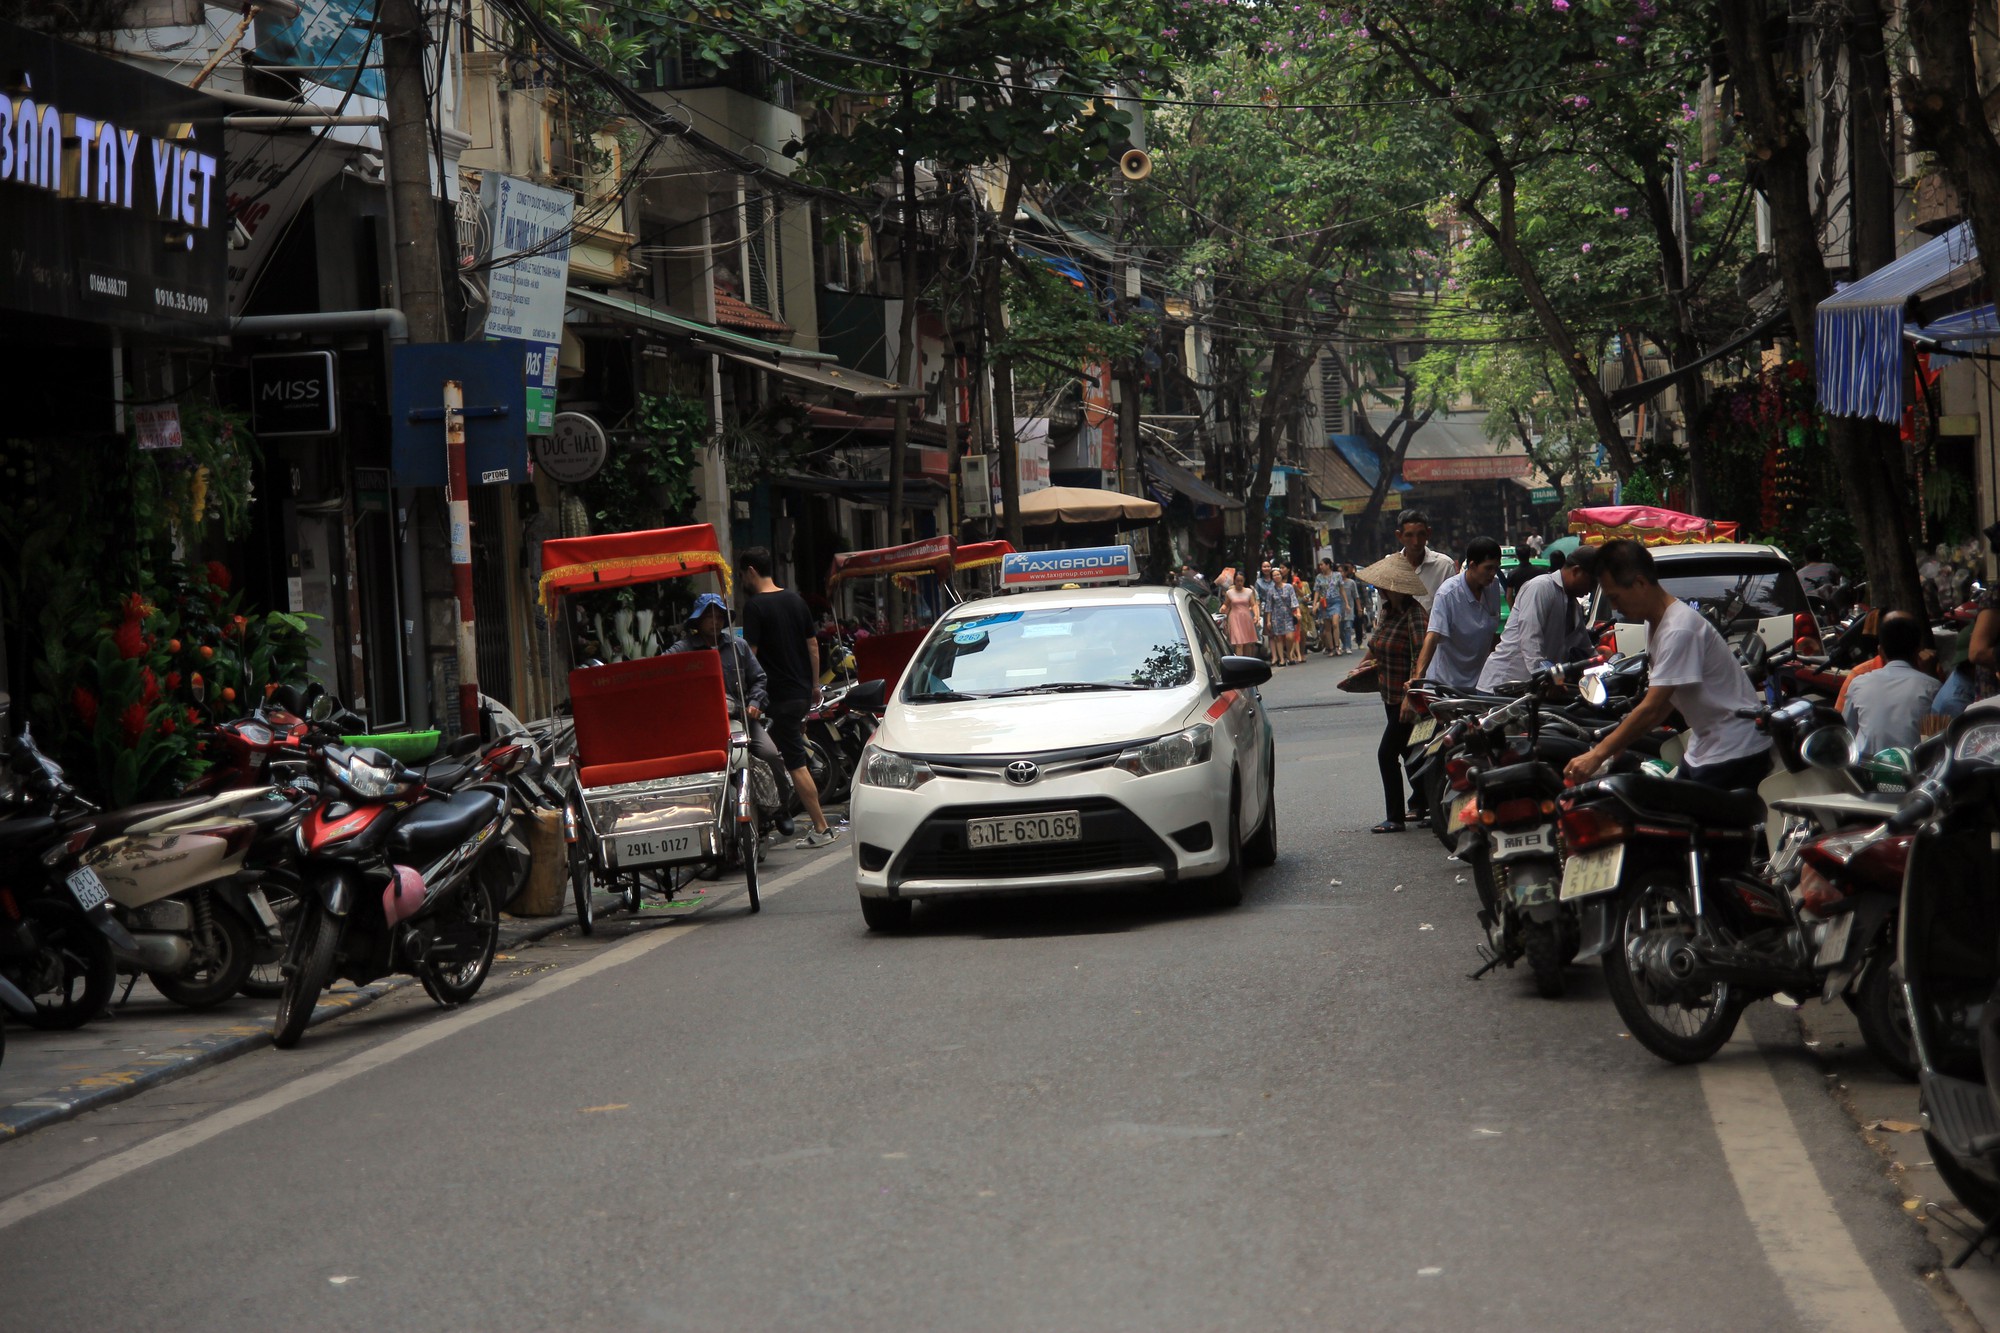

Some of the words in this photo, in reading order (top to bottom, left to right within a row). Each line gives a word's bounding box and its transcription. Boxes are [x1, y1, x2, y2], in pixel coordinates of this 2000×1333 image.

[75, 115, 140, 209] TAY
[151, 129, 217, 252] VIỆT
[155, 288, 209, 314] 0916.35.9999
[262, 379, 320, 401] MISS
[483, 470, 508, 480] OPTONE
[1019, 555, 1126, 573] TAXIGROUP
[1029, 569, 1104, 581] www.taxigroup.com.vn
[957, 633, 981, 643] 2263
[627, 837, 690, 858] 29XL-0127
[1504, 834, 1541, 848] 新日
[71, 870, 96, 893] 29-C1
[1569, 869, 1610, 894] 5121
[79, 883, 109, 909] 545.33
